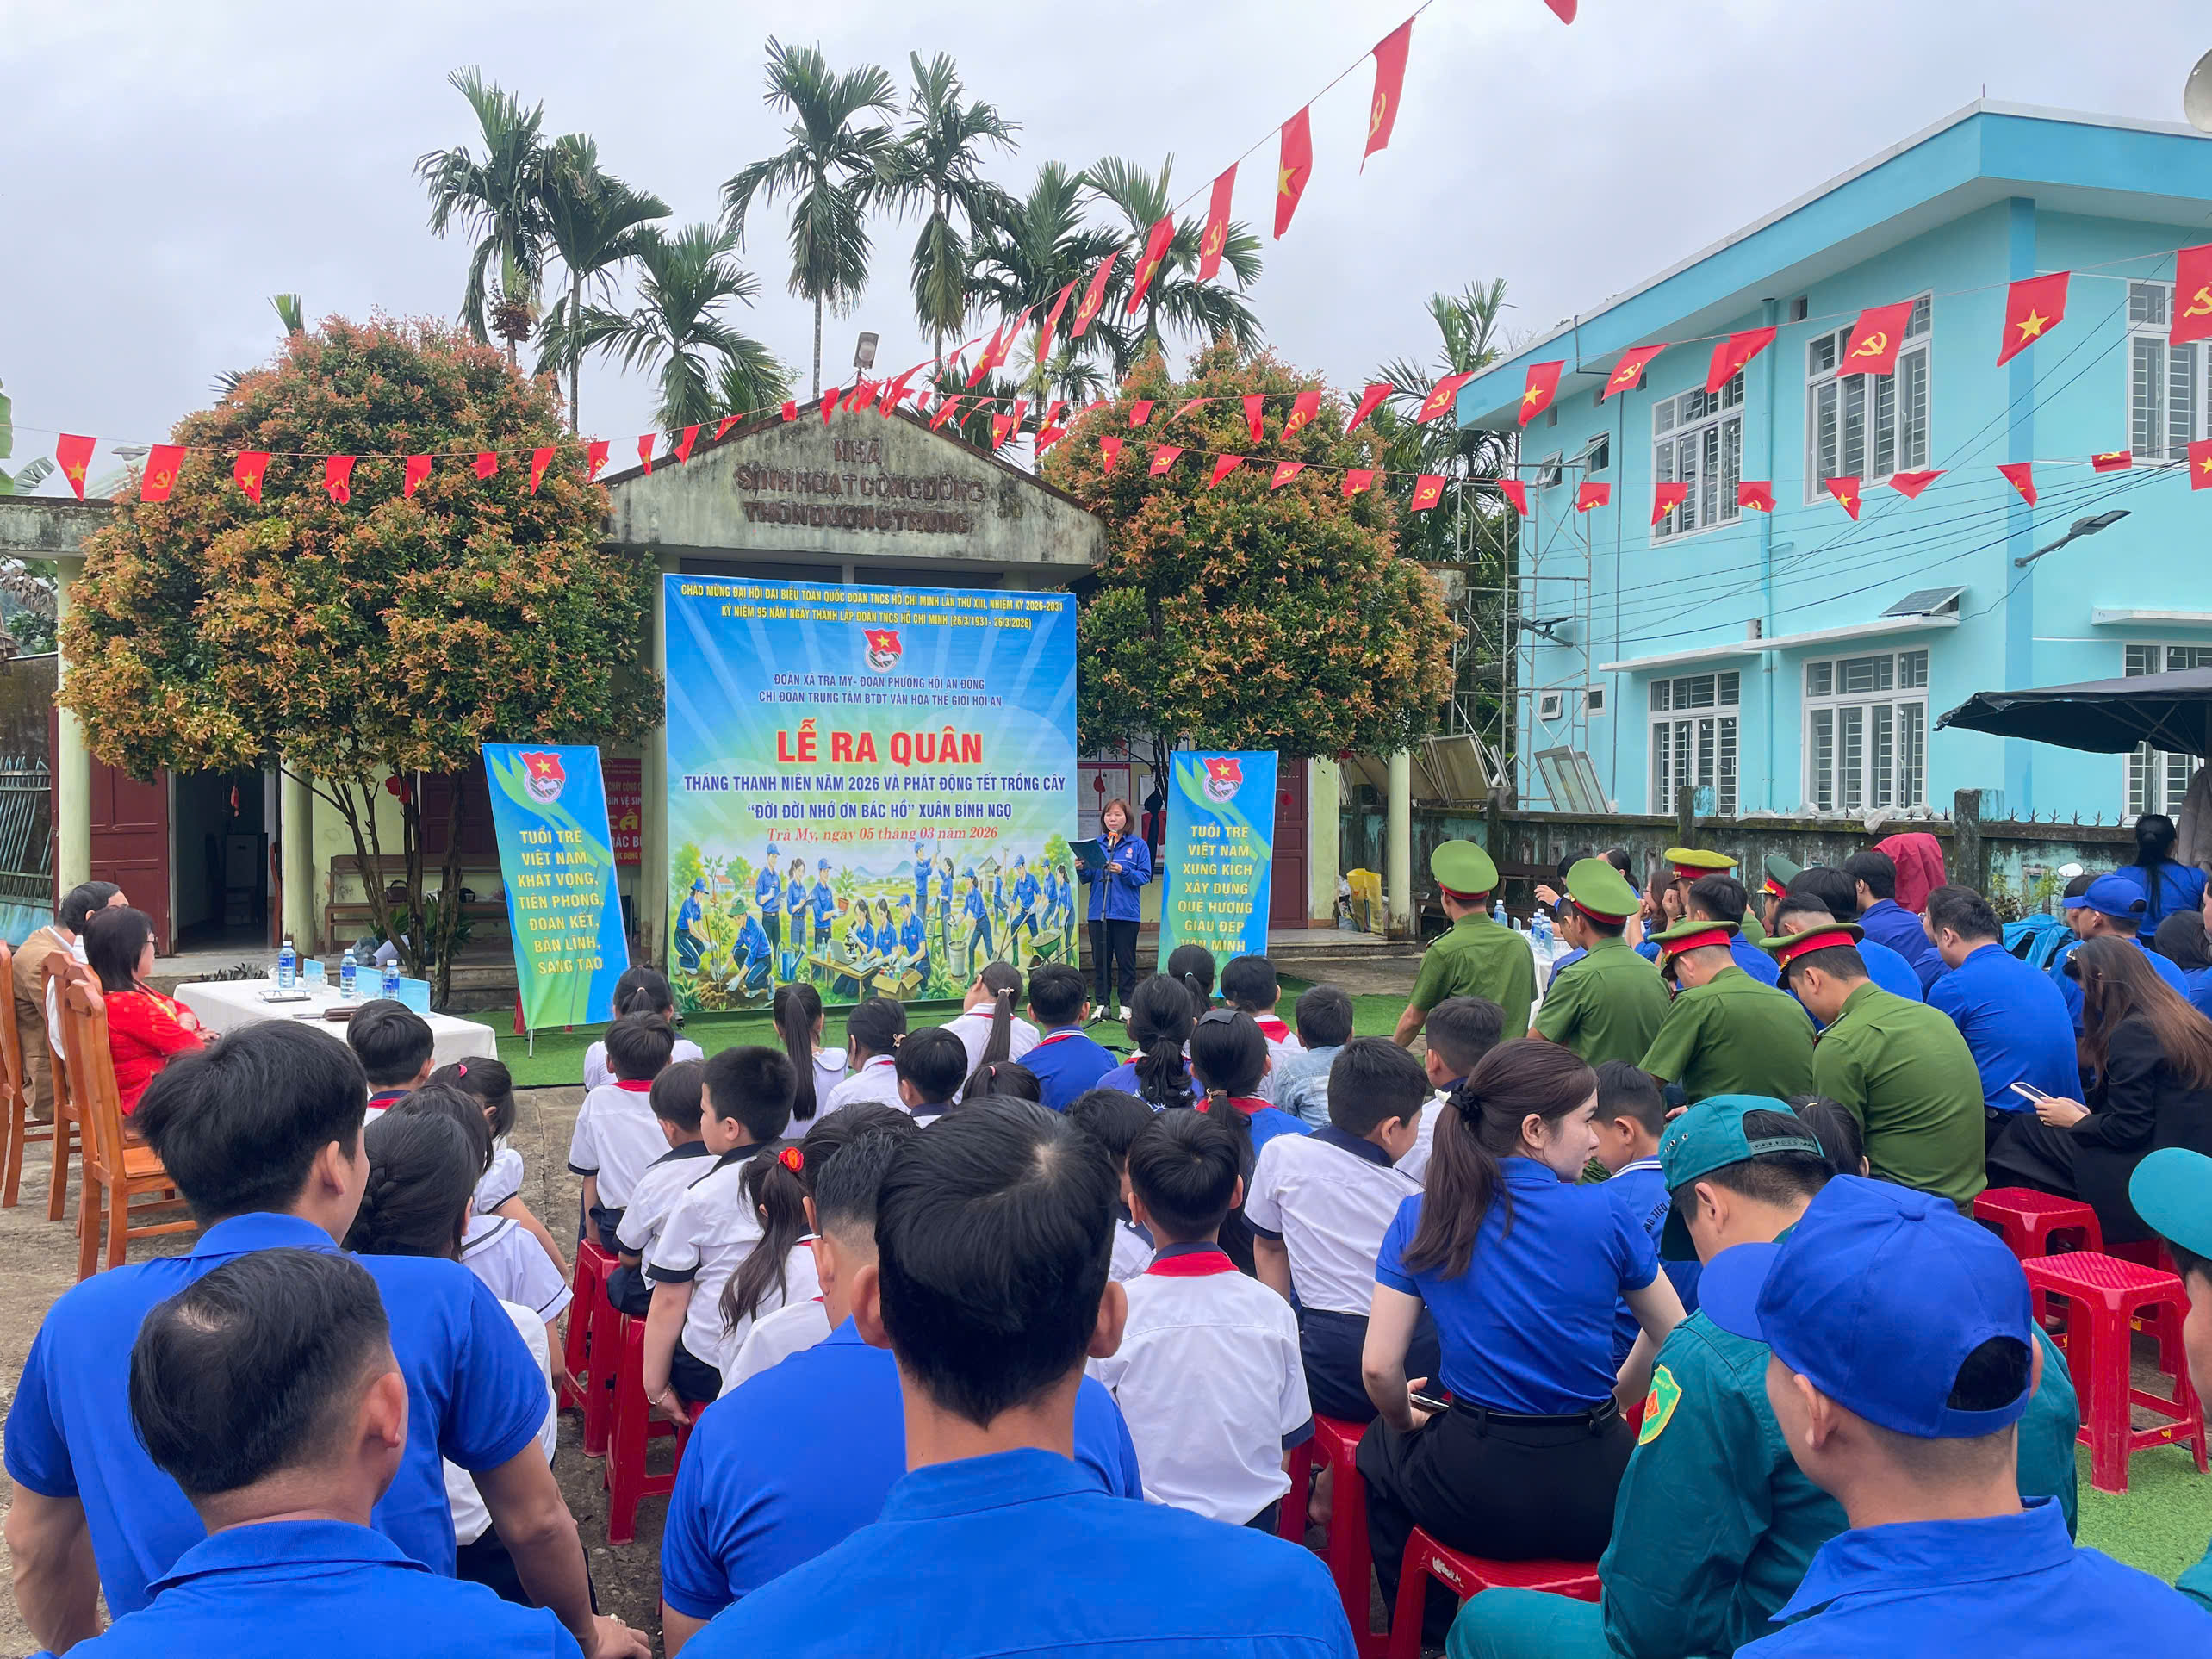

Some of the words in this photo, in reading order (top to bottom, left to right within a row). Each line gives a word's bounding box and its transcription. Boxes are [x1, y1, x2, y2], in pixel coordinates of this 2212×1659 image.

[681, 582, 704, 596] CHÀO
[732, 587, 746, 600] ĐẠI
[749, 586, 762, 600] HỘI
[765, 588, 779, 602] ĐẠI
[801, 587, 822, 601] TOÀN
[823, 587, 845, 602] QUỐC
[847, 590, 868, 603] ĐOÀN
[870, 593, 890, 605] TNCS
[892, 591, 902, 605] HỒ
[904, 593, 917, 606] CHÍ
[919, 595, 939, 606] MINH
[1026, 600, 1063, 612] 2026-2031
[757, 607, 767, 618] 95
[769, 605, 787, 618] NĂM
[789, 606, 810, 619] NGÀY
[856, 609, 877, 623] ĐOÀN
[879, 612, 898, 623] TNCS
[900, 609, 911, 624] HỒ
[929, 614, 948, 625] MINH
[947, 678, 958, 689] AN
[759, 691, 775, 702] CHI
[808, 692, 839, 703] TRUNG
[842, 690, 861, 704] TÂM
[865, 693, 887, 704] BTDT
[991, 696, 1002, 706] AN
[777, 718, 817, 763] LỄ
[831, 732, 878, 763] RA
[890, 726, 982, 766] QUÂN
[684, 773, 729, 791] THÁNG
[733, 776, 776, 791] THANH
[781, 774, 811, 791] NIÊN
[816, 774, 844, 791] NĂM
[848, 777, 879, 791] 2026
[884, 774, 899, 791] VÀ
[905, 774, 935, 791] PHÁT
[940, 774, 972, 793] ĐỘNG
[976, 772, 997, 791] TẾT
[1001, 773, 1039, 791] TRỒNG
[1043, 774, 1066, 791] CÂY
[631, 797, 641, 805] SIN
[782, 801, 805, 818] ĐỜI
[809, 800, 836, 818] NHỚ
[840, 804, 857, 818] ƠN
[861, 800, 885, 817] BÁC
[919, 800, 950, 817] XUÂN
[955, 800, 983, 817] BÍNH
[988, 804, 1011, 820] NGỌ
[519, 825, 552, 844] TUỔI
[556, 827, 582, 843] TRẺ
[767, 828, 791, 842] Trà
[795, 828, 818, 843] My,
[823, 830, 856, 843] ngày
[859, 827, 874, 840] 05
[878, 827, 916, 842] tháng
[920, 828, 935, 840] 03
[938, 829, 966, 840] năm
[969, 827, 998, 838] 2026
[1190, 822, 1220, 838] TUỔI
[1225, 823, 1248, 838] TRẺ
[521, 849, 551, 868] VIỆT
[556, 851, 587, 865] NAM
[1188, 842, 1216, 858] VIỆT
[1221, 845, 1250, 856] NAM
[1183, 863, 1217, 875] XUNG
[518, 871, 551, 887] KHÁT
[556, 872, 599, 889] VỌNG,
[1185, 879, 1209, 893] XÂY
[1213, 882, 1248, 896] DỰNG
[518, 893, 548, 910] TIÊN
[551, 893, 605, 909] PHONG,
[1177, 899, 1203, 913] QUÊ
[1209, 901, 1252, 914] HƯƠNG
[569, 910, 600, 929] KẾT,
[1219, 921, 1245, 935] ĐẸP
[1211, 939, 1246, 952] MINH
